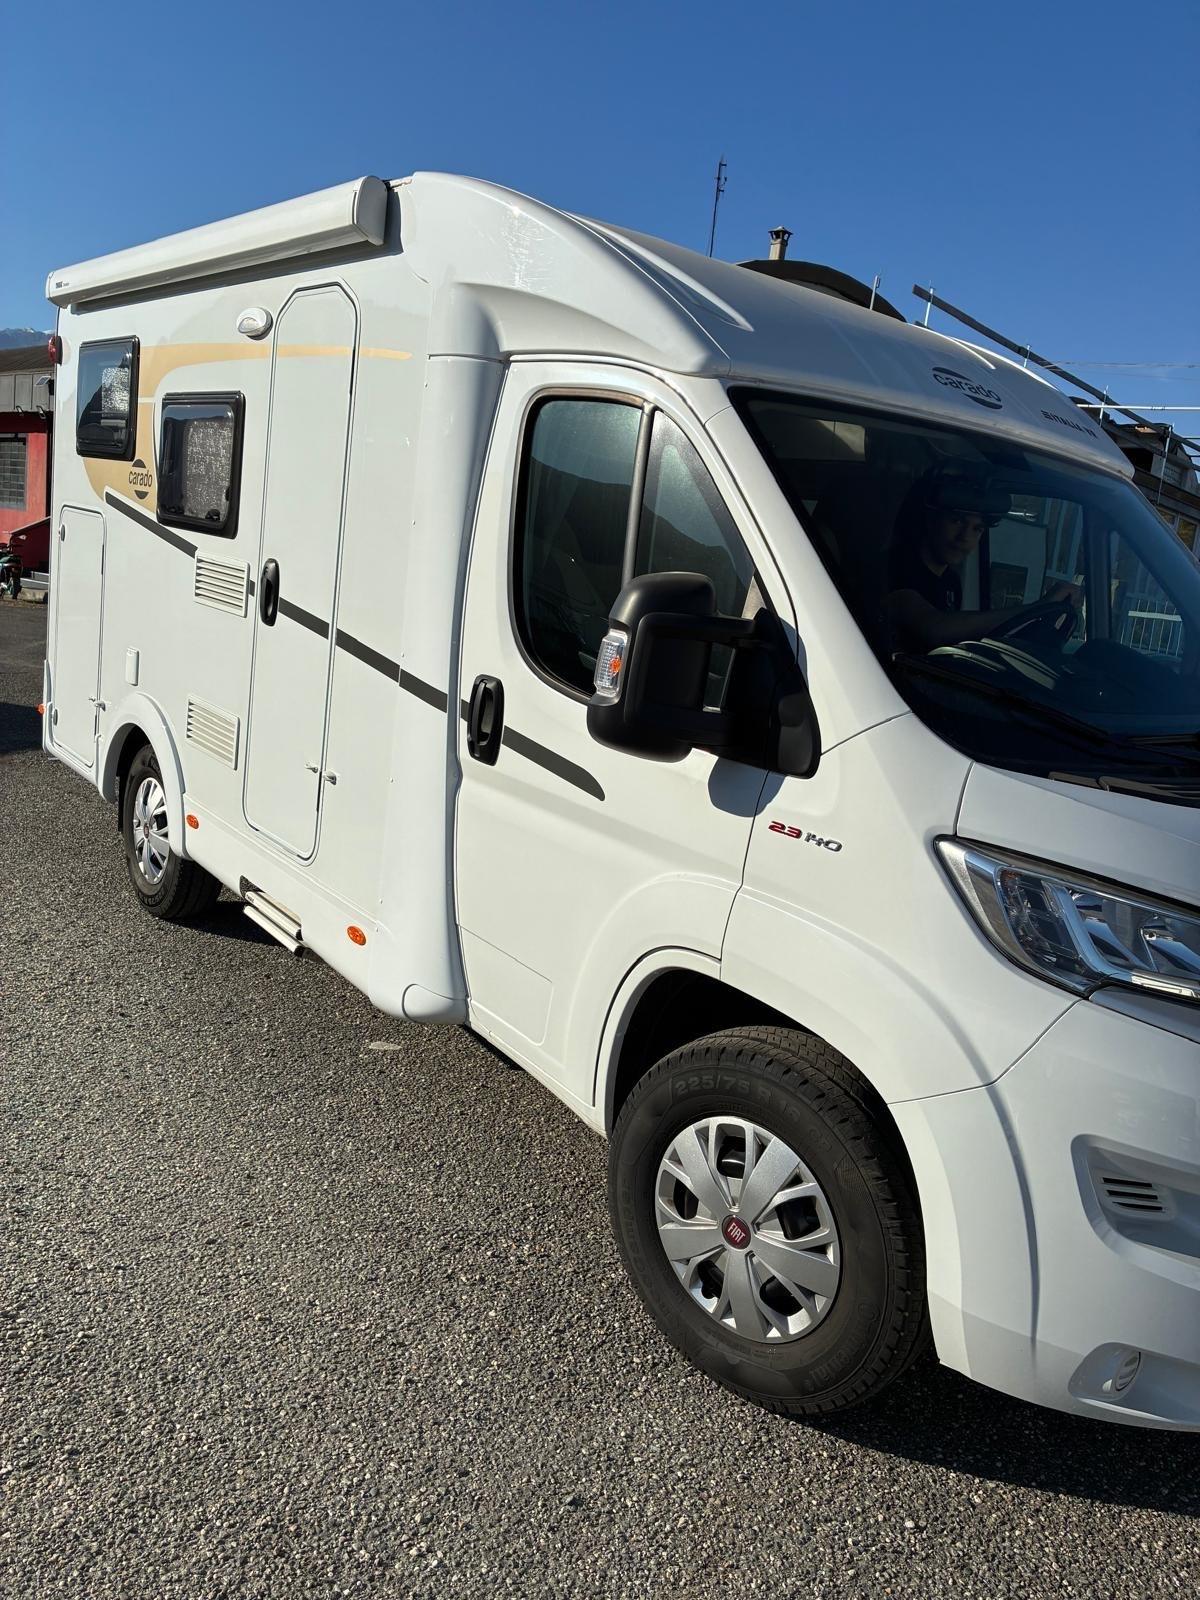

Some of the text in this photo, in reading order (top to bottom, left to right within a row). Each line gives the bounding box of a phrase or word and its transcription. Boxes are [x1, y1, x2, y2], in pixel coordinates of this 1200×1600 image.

[932, 373, 1002, 402] carado
[128, 470, 153, 487] carado
[804, 832, 843, 852] 140
[727, 1222, 746, 1243] FIAT
